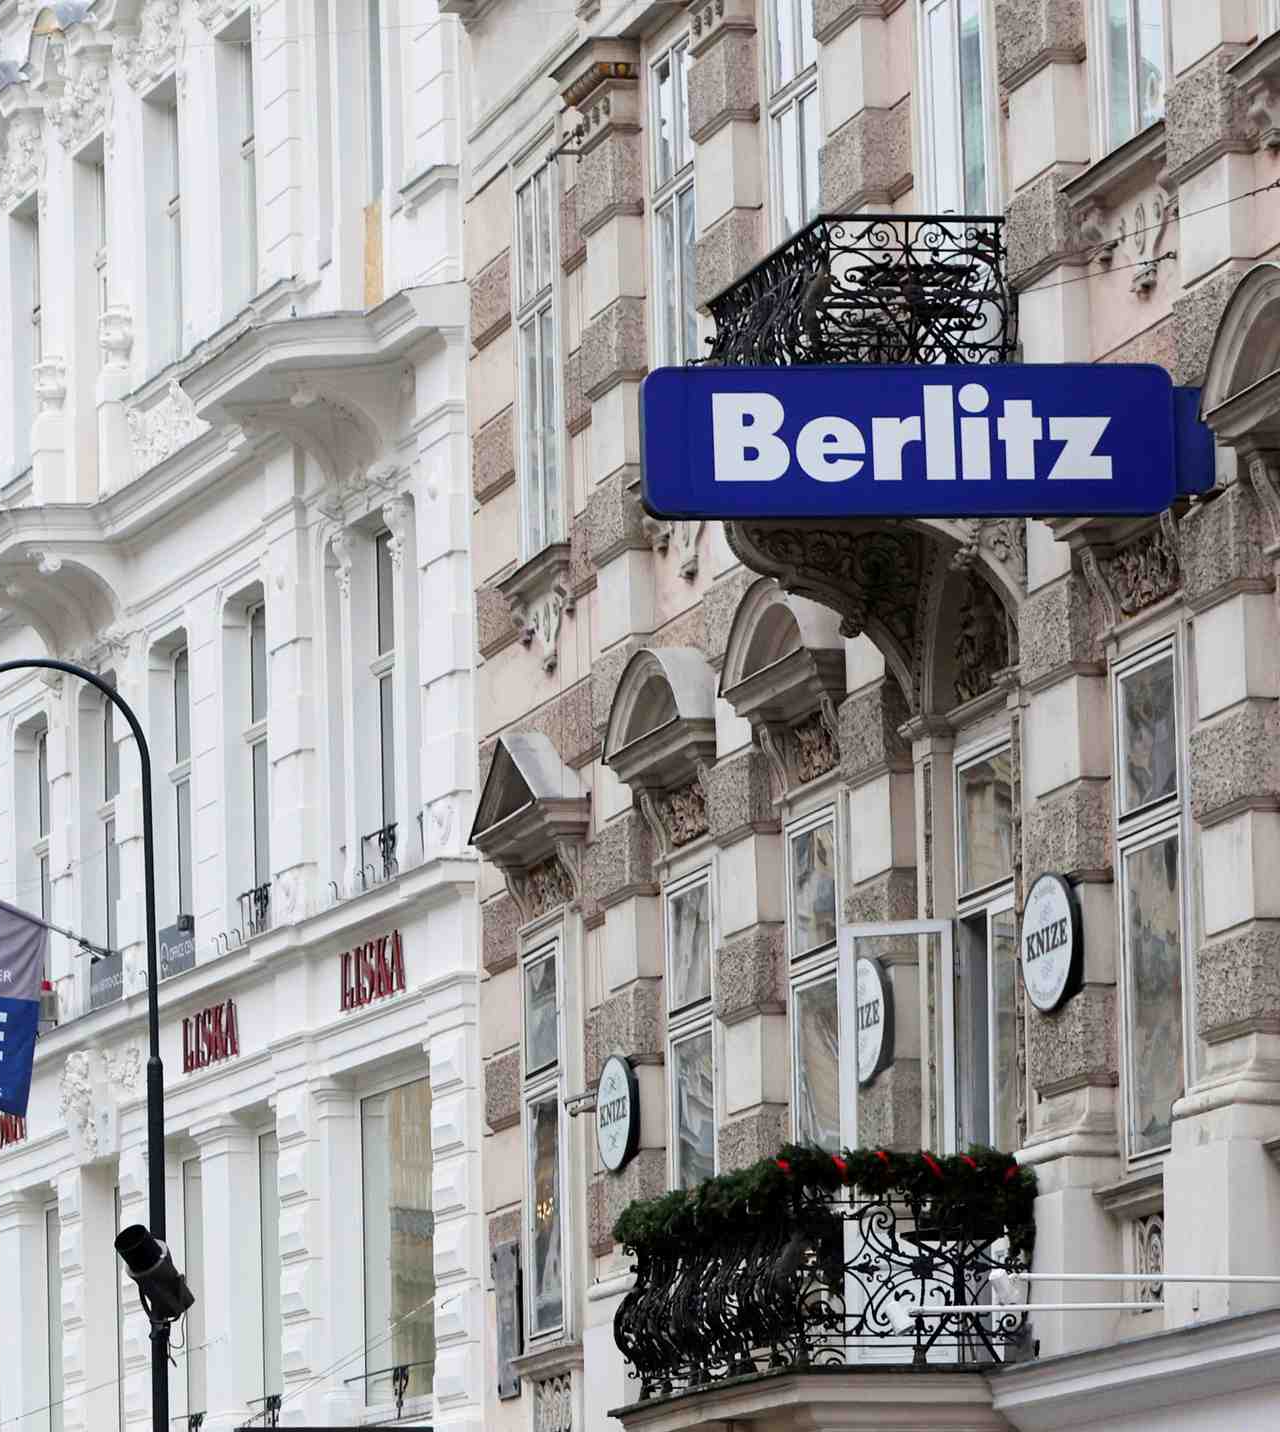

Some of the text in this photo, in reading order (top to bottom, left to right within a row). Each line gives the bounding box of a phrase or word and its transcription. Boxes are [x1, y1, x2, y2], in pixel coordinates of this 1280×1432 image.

[711, 383, 1113, 482] Berlitz
[340, 928, 407, 1012] LISKA
[1026, 917, 1068, 962] KNIZE
[182, 998, 239, 1074] LISKA
[600, 1095, 627, 1129] KNIZE
